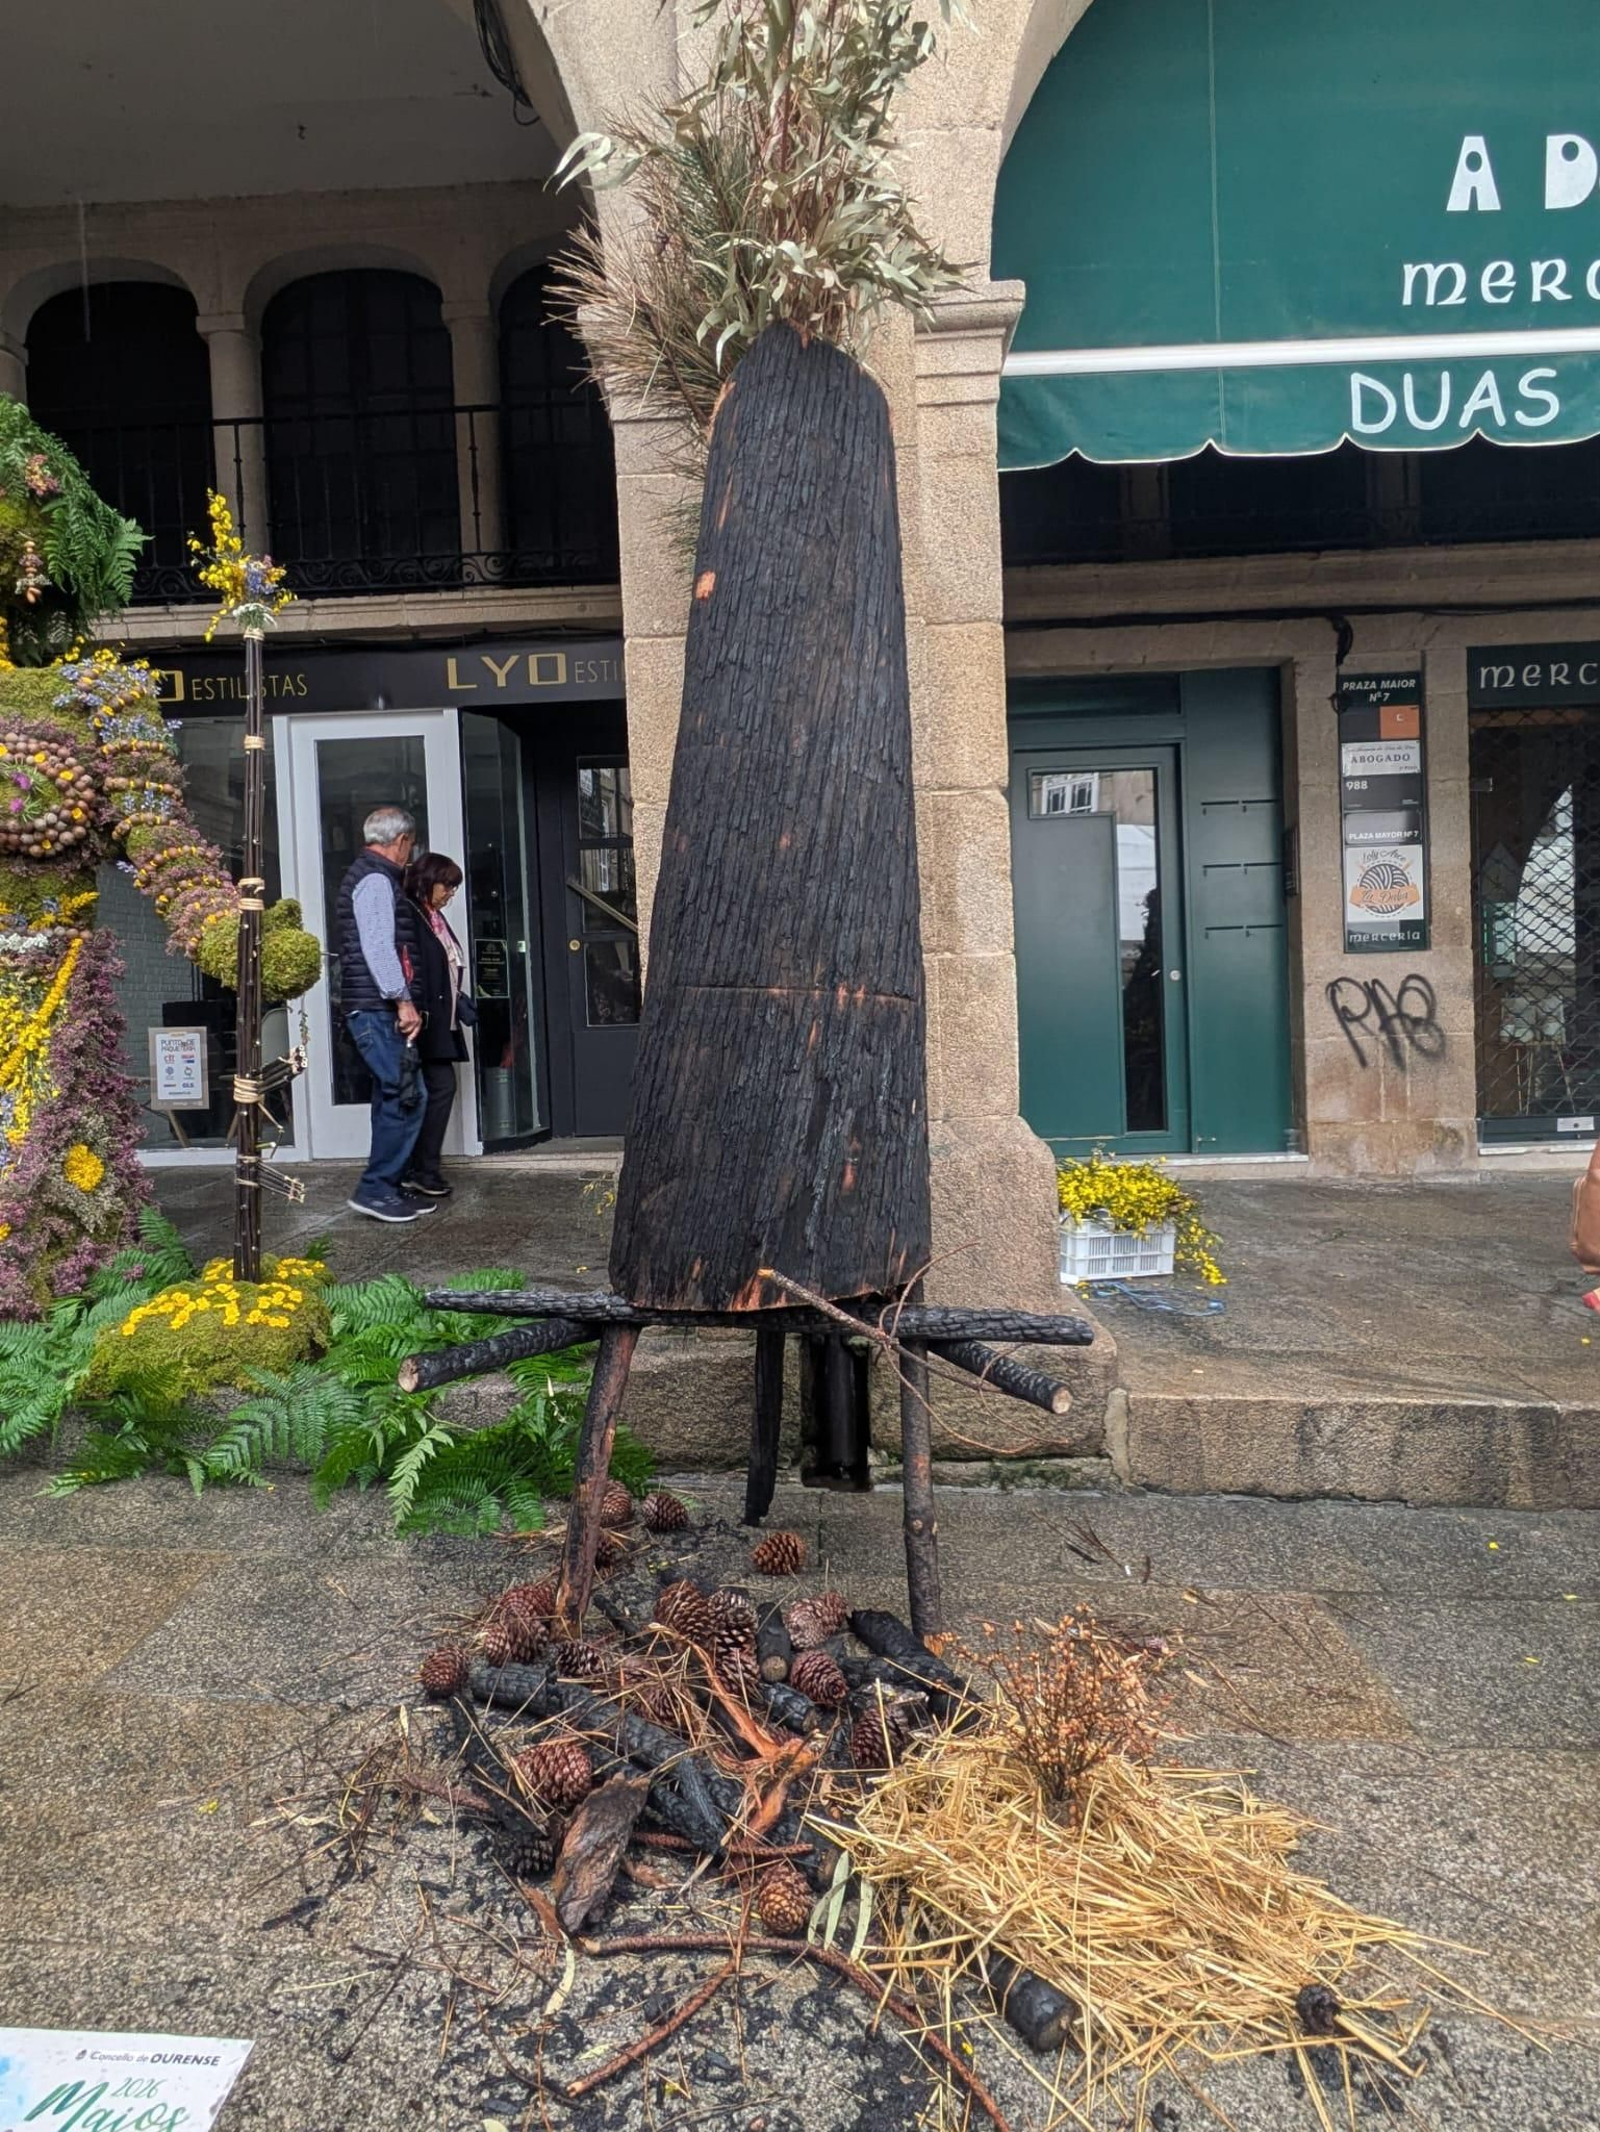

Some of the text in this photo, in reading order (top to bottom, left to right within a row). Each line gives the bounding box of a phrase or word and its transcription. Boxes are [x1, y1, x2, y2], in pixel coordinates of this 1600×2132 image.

[1446, 134, 1600, 212] A D
[1350, 367, 1561, 434] DUAS
[447, 652, 567, 690] LYO
[191, 673, 309, 701] ESTILSTAS
[1342, 679, 1417, 691] PRAZA MAIOR
[1383, 692, 1391, 702] 7
[1350, 752, 1411, 765] ABOGADO
[1345, 780, 1369, 791] 988
[1348, 832, 1374, 841] PLAZA
[1374, 830, 1403, 840] MAYOR
[90, 2051, 223, 2067] Concello de OURENSE
[110, 2076, 168, 2099] 2026
[23, 2079, 190, 2132] Maios
